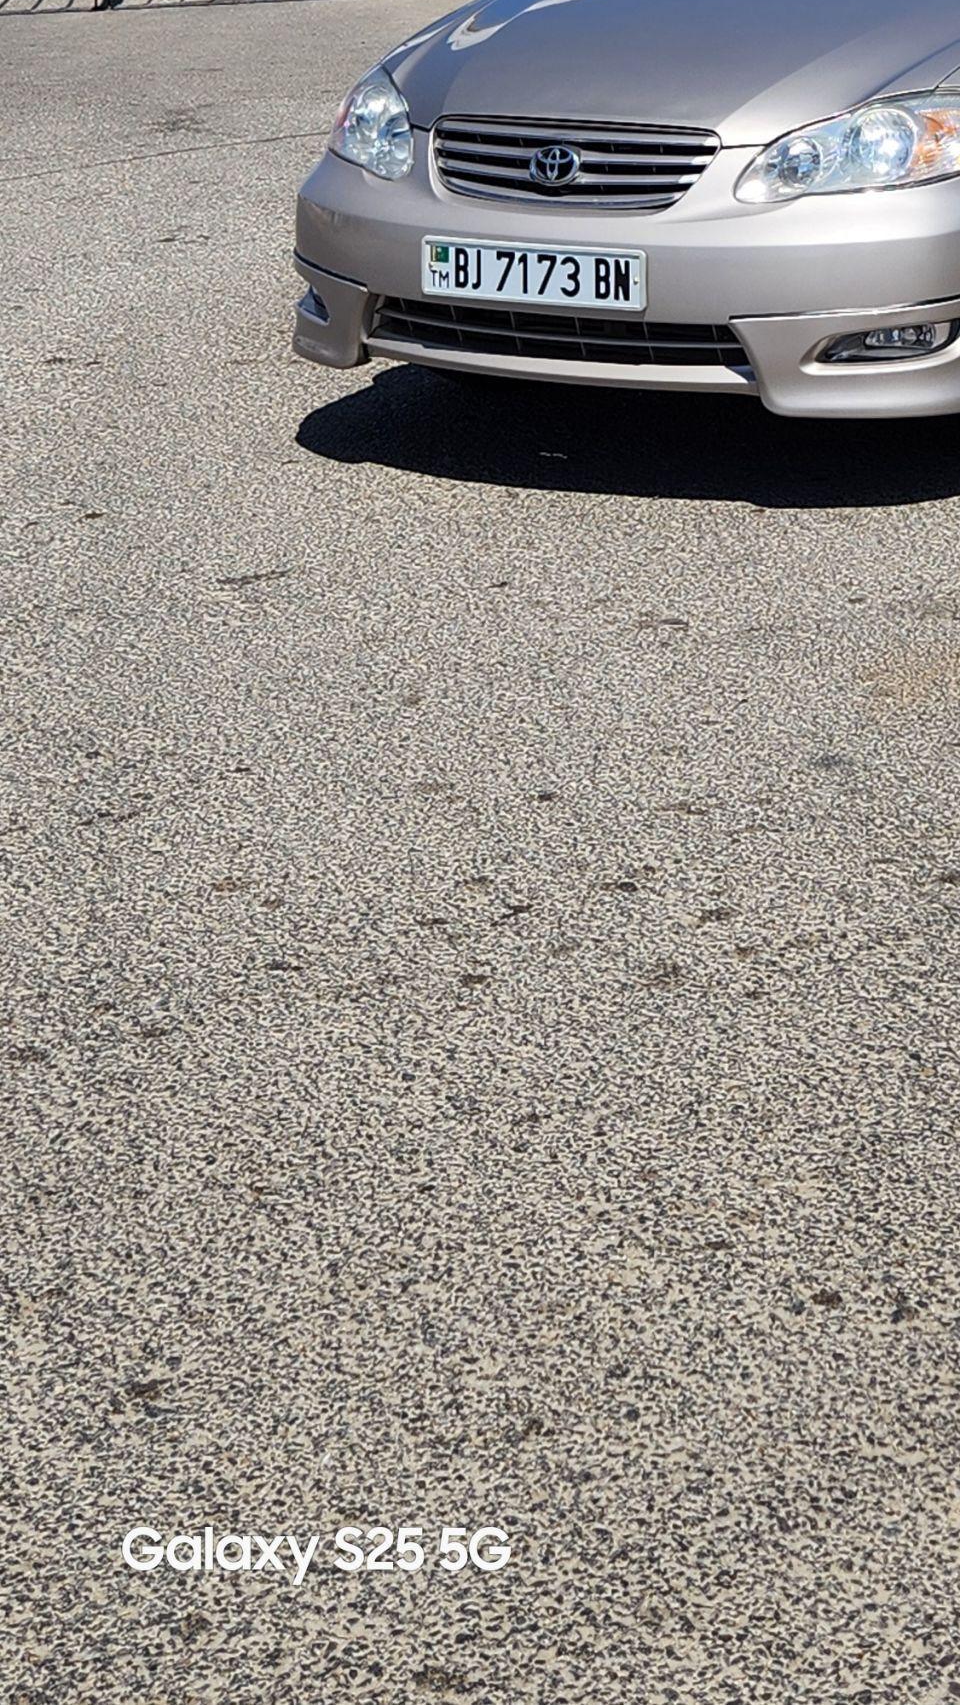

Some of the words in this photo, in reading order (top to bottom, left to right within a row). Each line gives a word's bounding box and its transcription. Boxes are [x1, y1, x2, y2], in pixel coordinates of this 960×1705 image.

[431, 269, 450, 289] TM
[454, 247, 482, 290] BJ
[496, 250, 581, 298] 7173
[594, 257, 631, 302] BN
